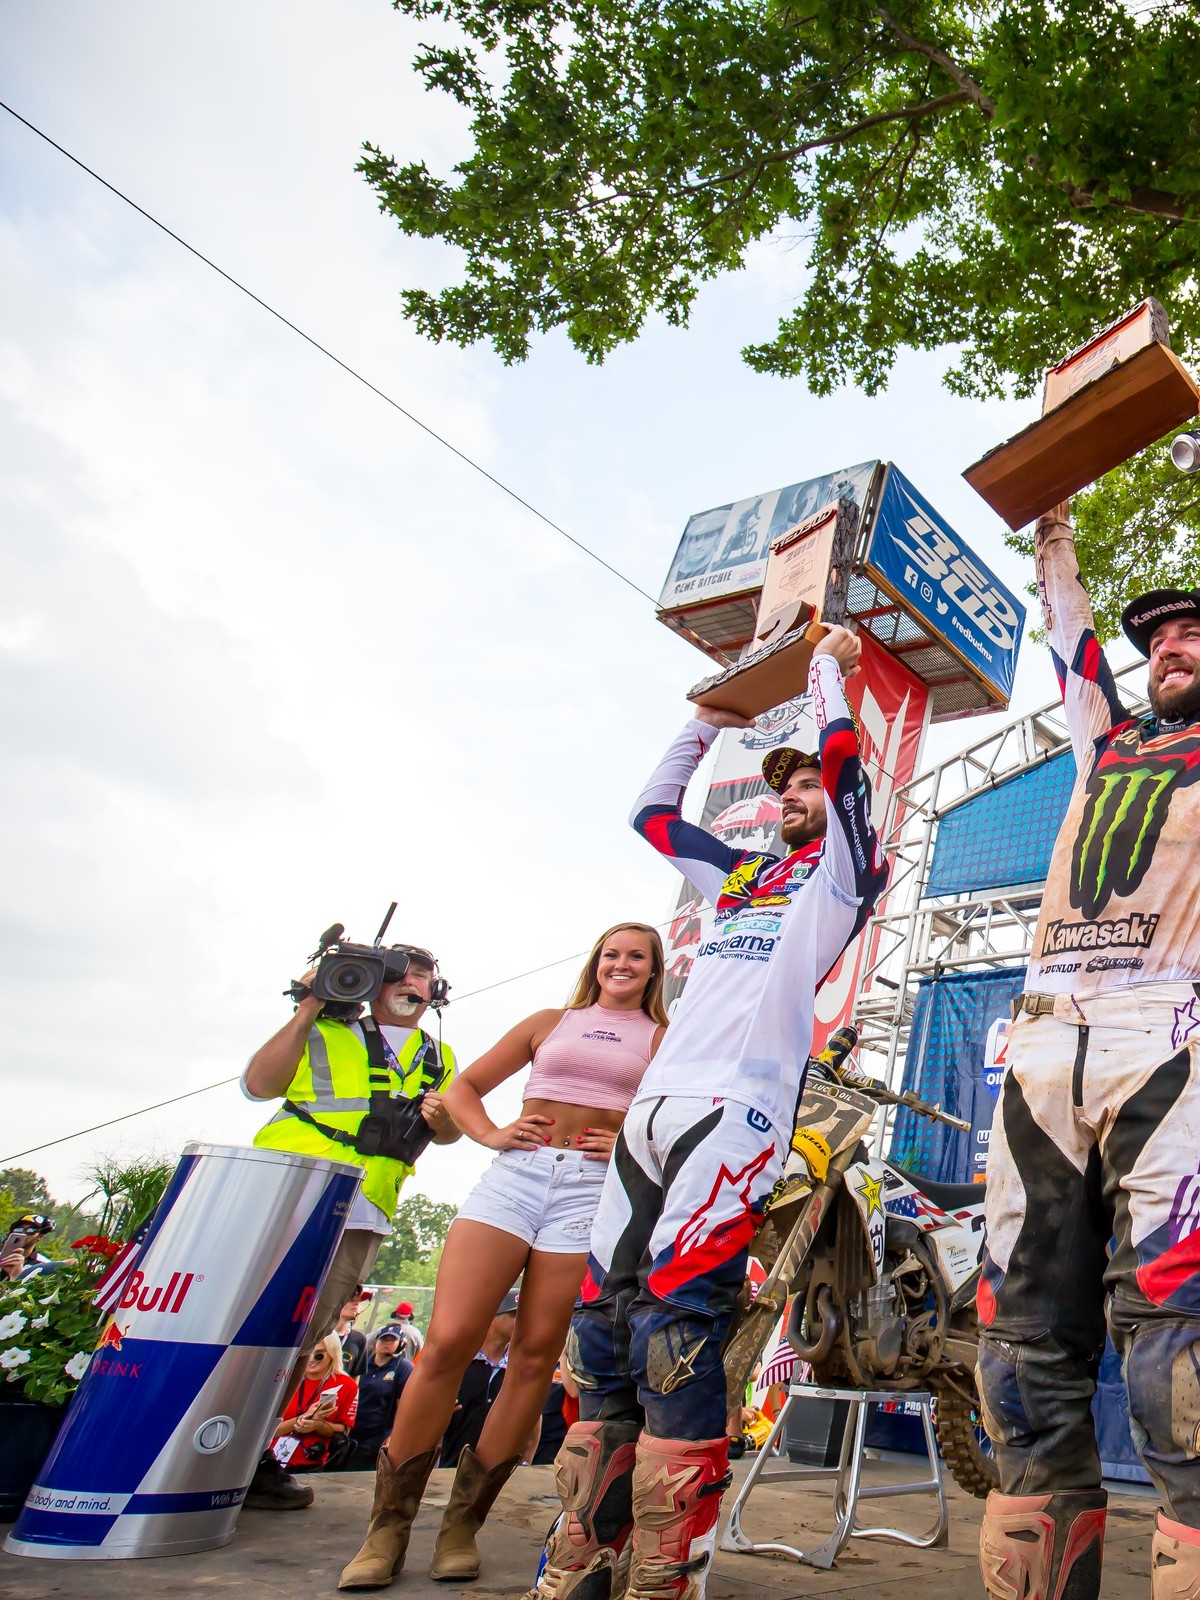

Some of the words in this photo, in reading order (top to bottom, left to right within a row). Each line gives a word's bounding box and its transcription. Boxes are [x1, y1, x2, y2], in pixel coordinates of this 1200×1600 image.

[784, 537, 816, 565] 2019
[674, 580, 697, 594] GENE
[699, 570, 733, 588] RITCHIE
[1130, 599, 1196, 627] Kawasaki
[951, 615, 993, 662] #redbudmx
[736, 921, 778, 932] MOTOREX
[1043, 914, 1159, 955] Kawasaki
[746, 954, 770, 963] RACING
[1045, 963, 1082, 974] DUNLOP
[838, 1090, 852, 1102] OIL
[119, 1271, 194, 1314] Bull
[904, 1401, 921, 1411] PRO
[34, 1492, 53, 1511] body
[55, 1497, 75, 1509] and
[77, 1497, 111, 1511] mind.
[211, 1492, 230, 1507] With
